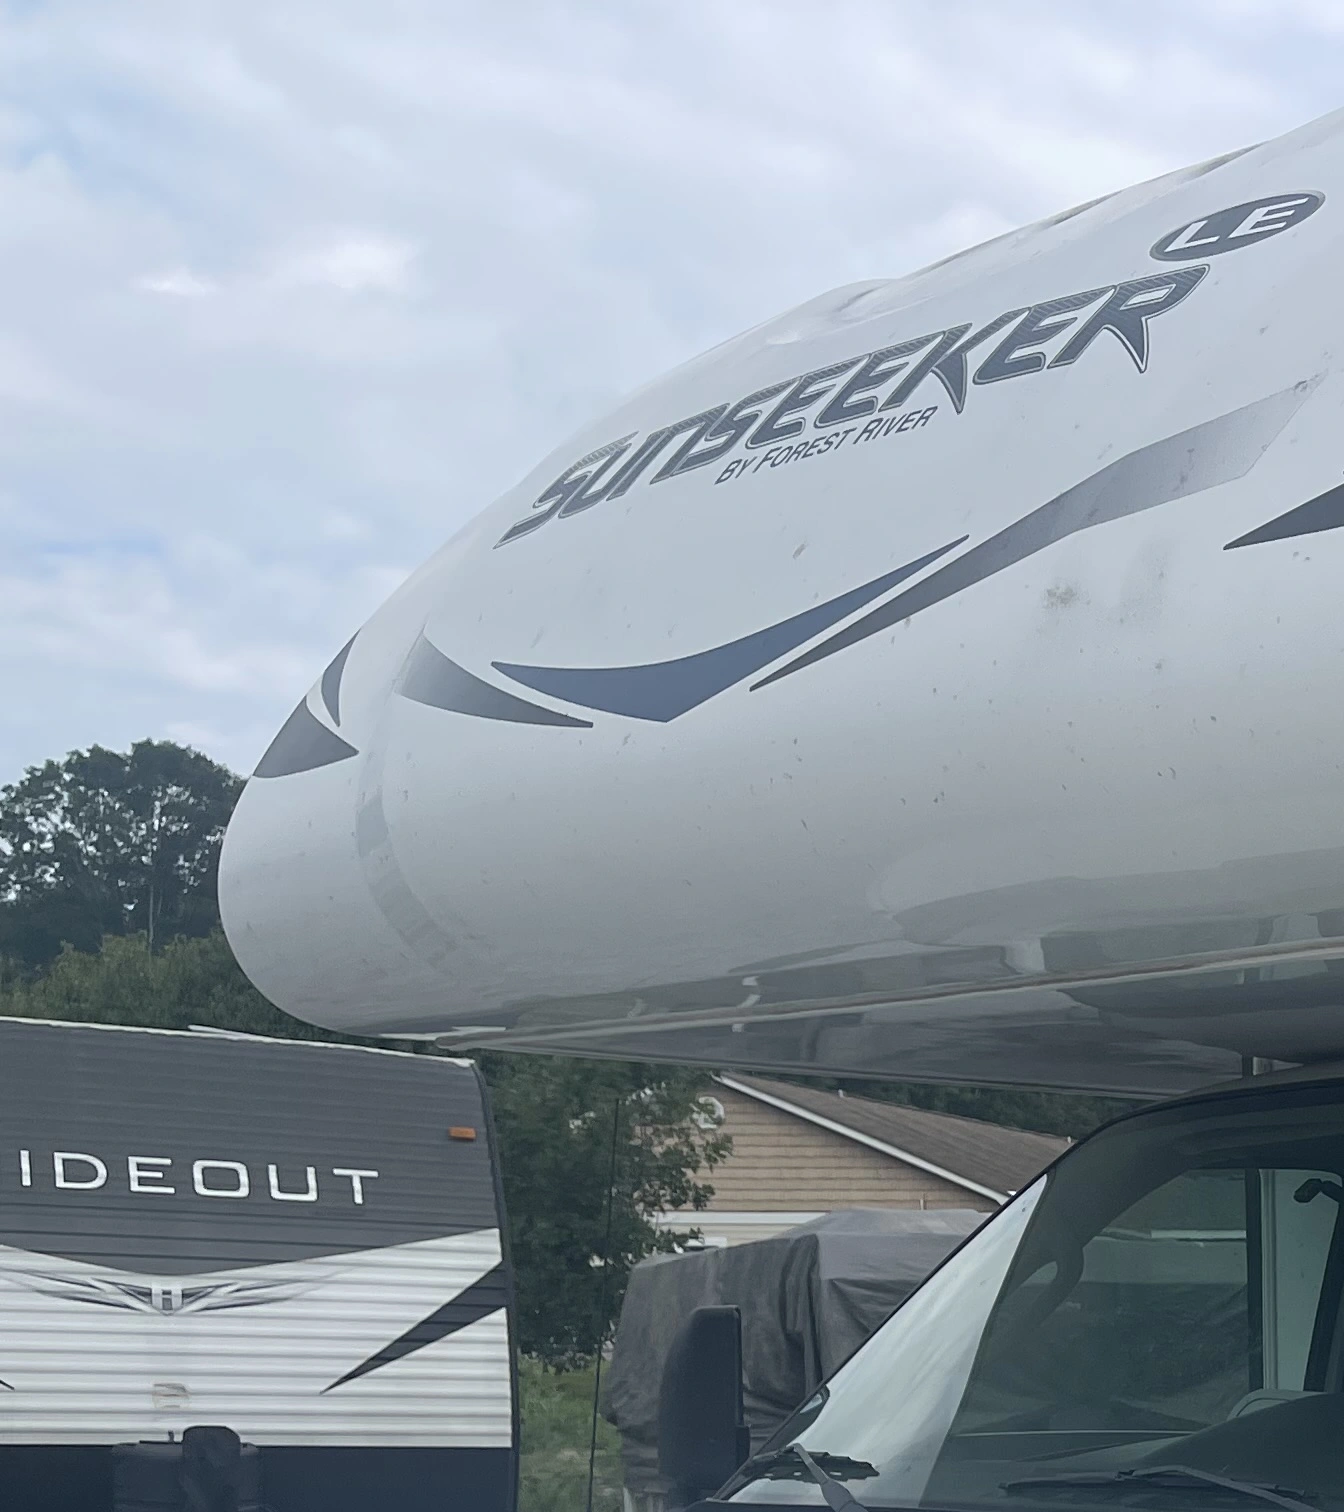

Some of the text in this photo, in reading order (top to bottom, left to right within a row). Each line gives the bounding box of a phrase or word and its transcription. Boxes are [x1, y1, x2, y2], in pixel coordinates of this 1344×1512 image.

[1164, 198, 1309, 253] LE
[493, 264, 1211, 549] SUNSEEKER
[713, 406, 939, 486] BY FOREST RIVER
[19, 1149, 380, 1205] IDEOUT
